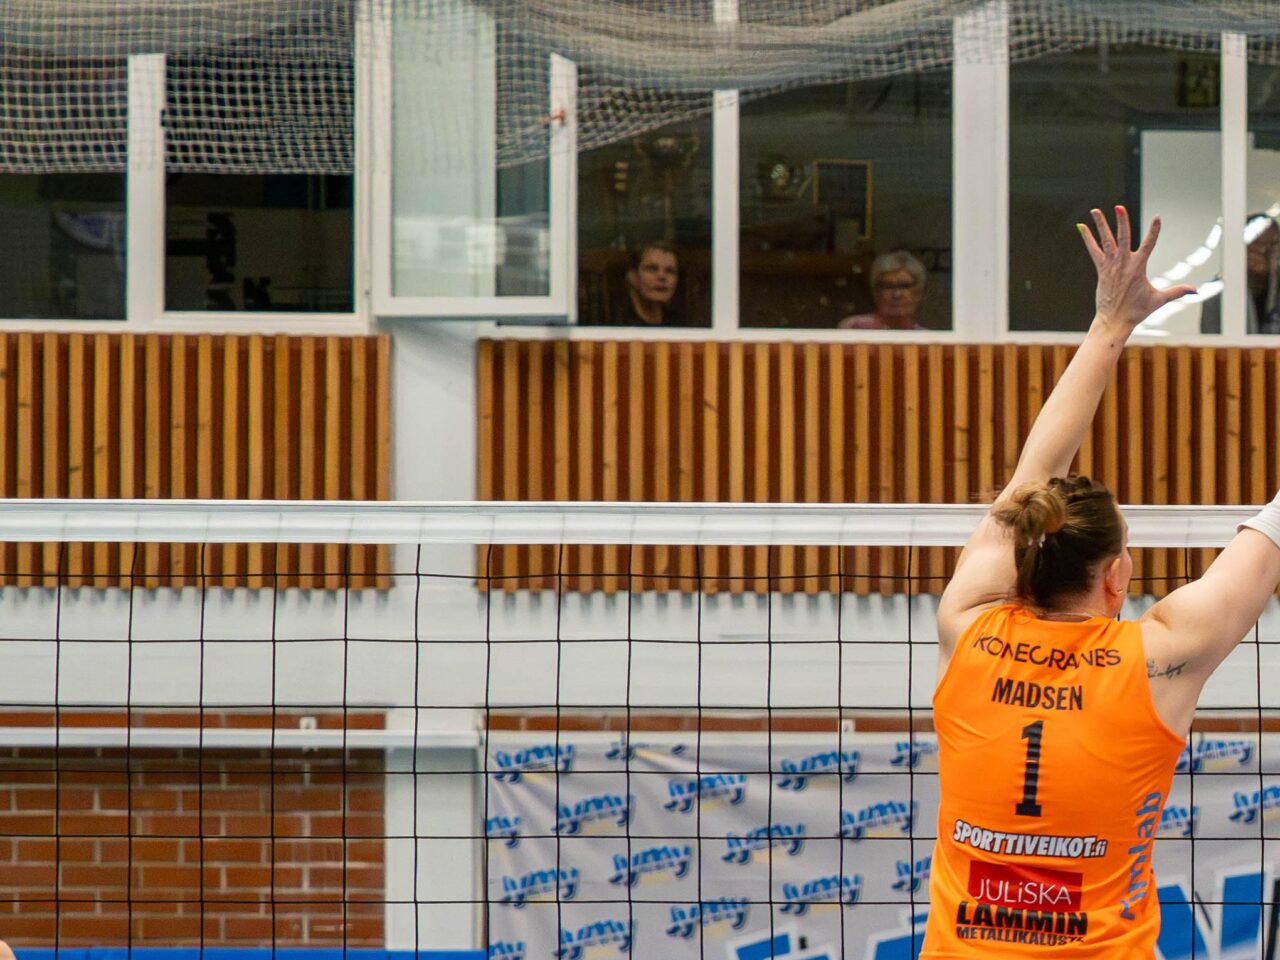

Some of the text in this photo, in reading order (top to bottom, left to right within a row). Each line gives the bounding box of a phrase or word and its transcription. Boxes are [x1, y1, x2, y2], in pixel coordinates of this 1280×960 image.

[973, 632, 1122, 671] KONECRANES
[991, 677, 1083, 710] MADSEN
[1015, 721, 1044, 817] 1
[953, 821, 1108, 858] SPORTTIVEIKOT.fi
[957, 901, 1088, 935] LAMMIN
